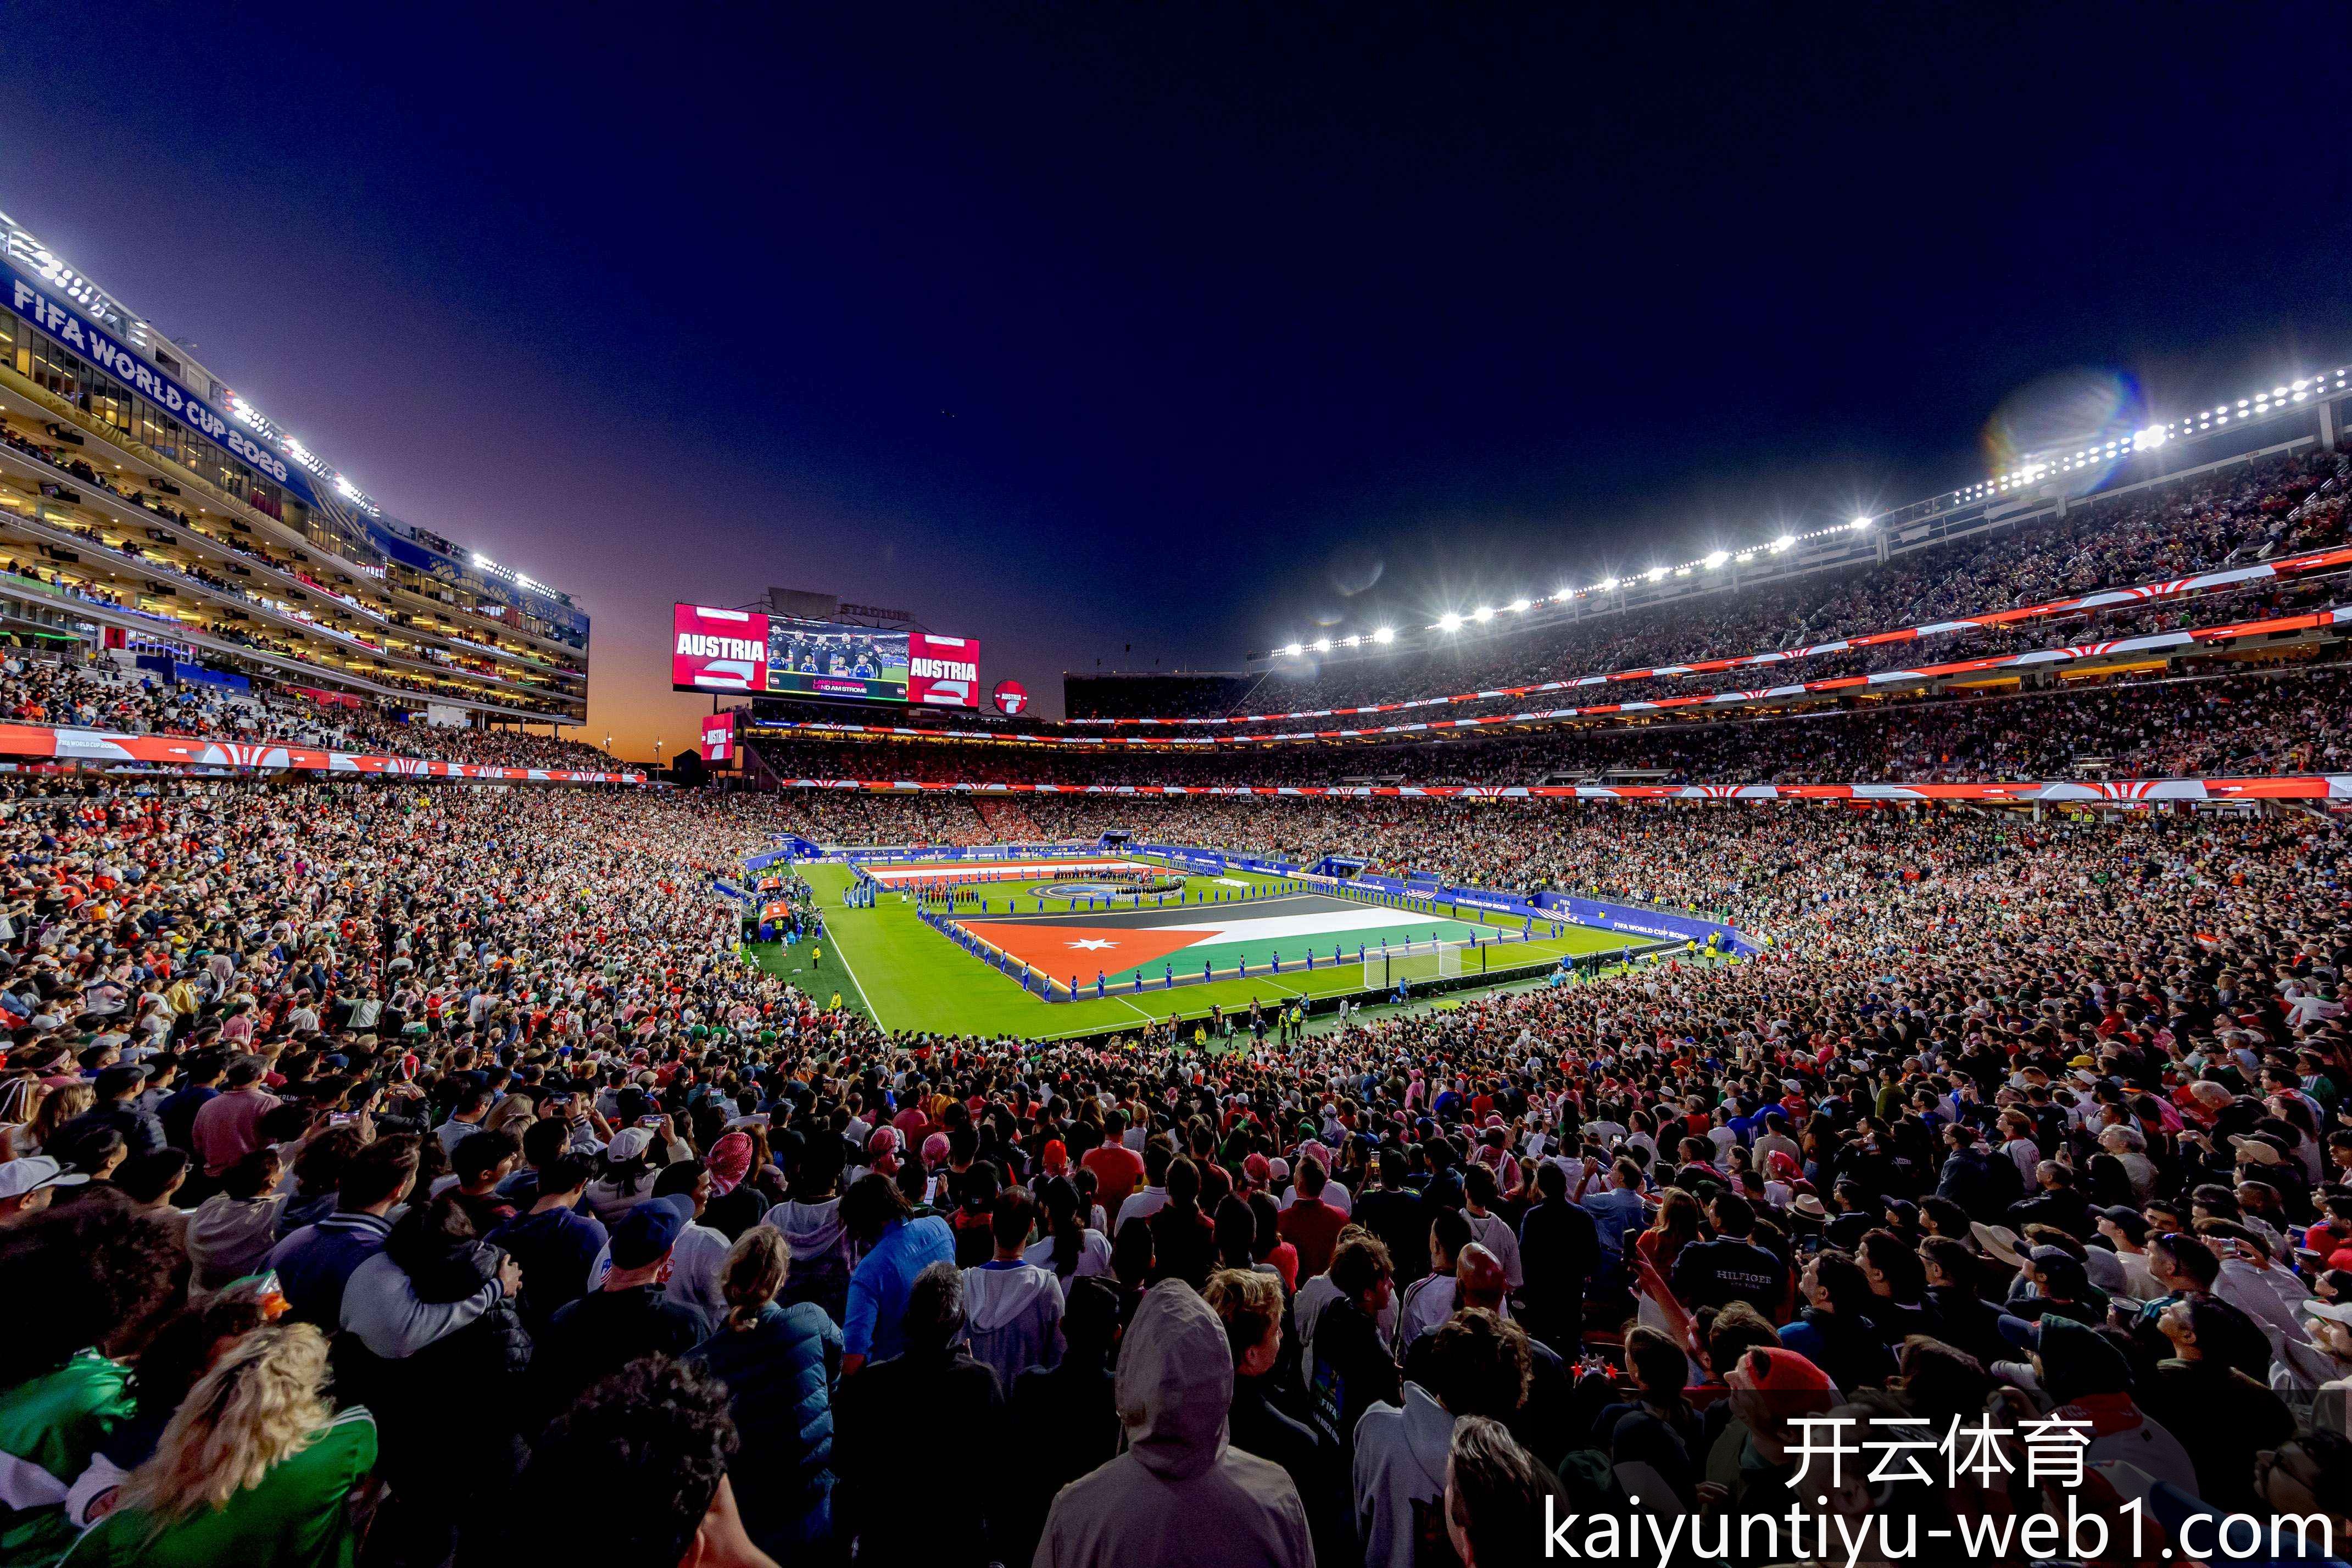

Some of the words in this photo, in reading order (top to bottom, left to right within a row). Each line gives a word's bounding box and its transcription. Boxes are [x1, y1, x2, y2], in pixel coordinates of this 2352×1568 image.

[14, 280, 85, 350] FIFA
[90, 331, 185, 411] WORLD
[186, 400, 226, 438] CUP
[228, 429, 288, 482] 2026
[677, 633, 765, 662] AUSTRIA
[910, 657, 977, 682] AUSTRIA
[707, 728, 726, 745] AUSTRIA
[1629, 924, 1653, 934] WORLD
[1717, 1270, 1771, 1284] HILFIGER
[1321, 1398, 1336, 1421] FIFA
